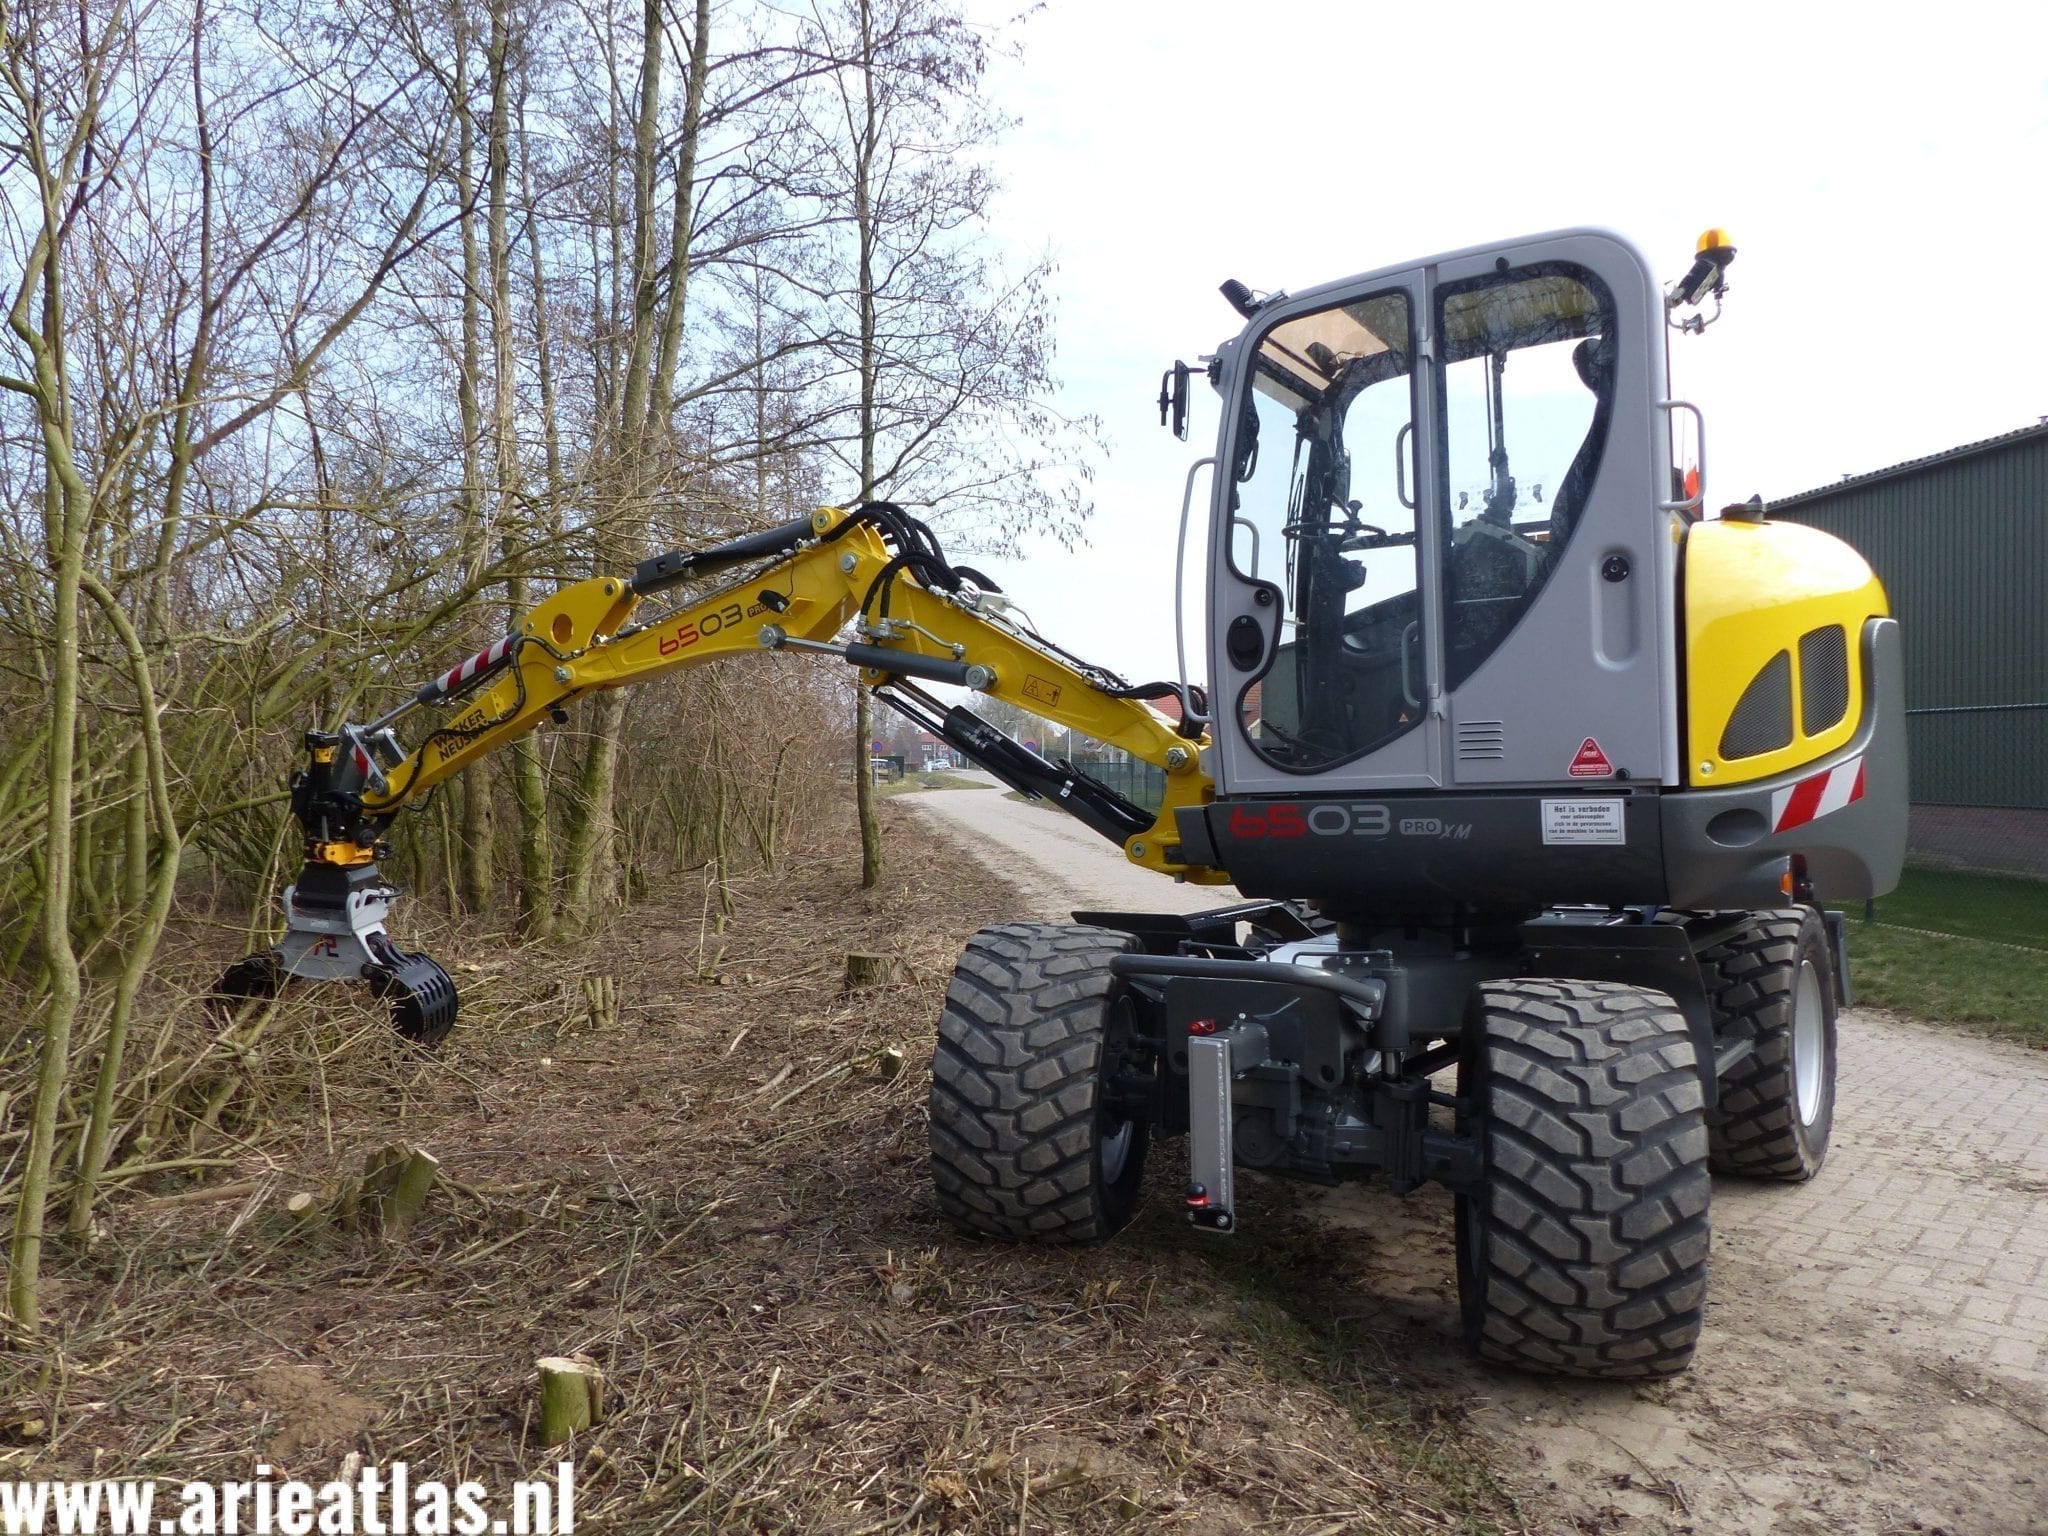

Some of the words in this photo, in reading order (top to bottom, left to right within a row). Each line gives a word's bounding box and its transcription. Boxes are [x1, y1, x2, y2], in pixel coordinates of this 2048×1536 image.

[659, 604, 743, 656] 6503
[438, 730, 484, 762] NEUS
[1229, 804, 1390, 837] 6503
[1403, 820, 1438, 833] PRO
[1439, 824, 1473, 840] XM
